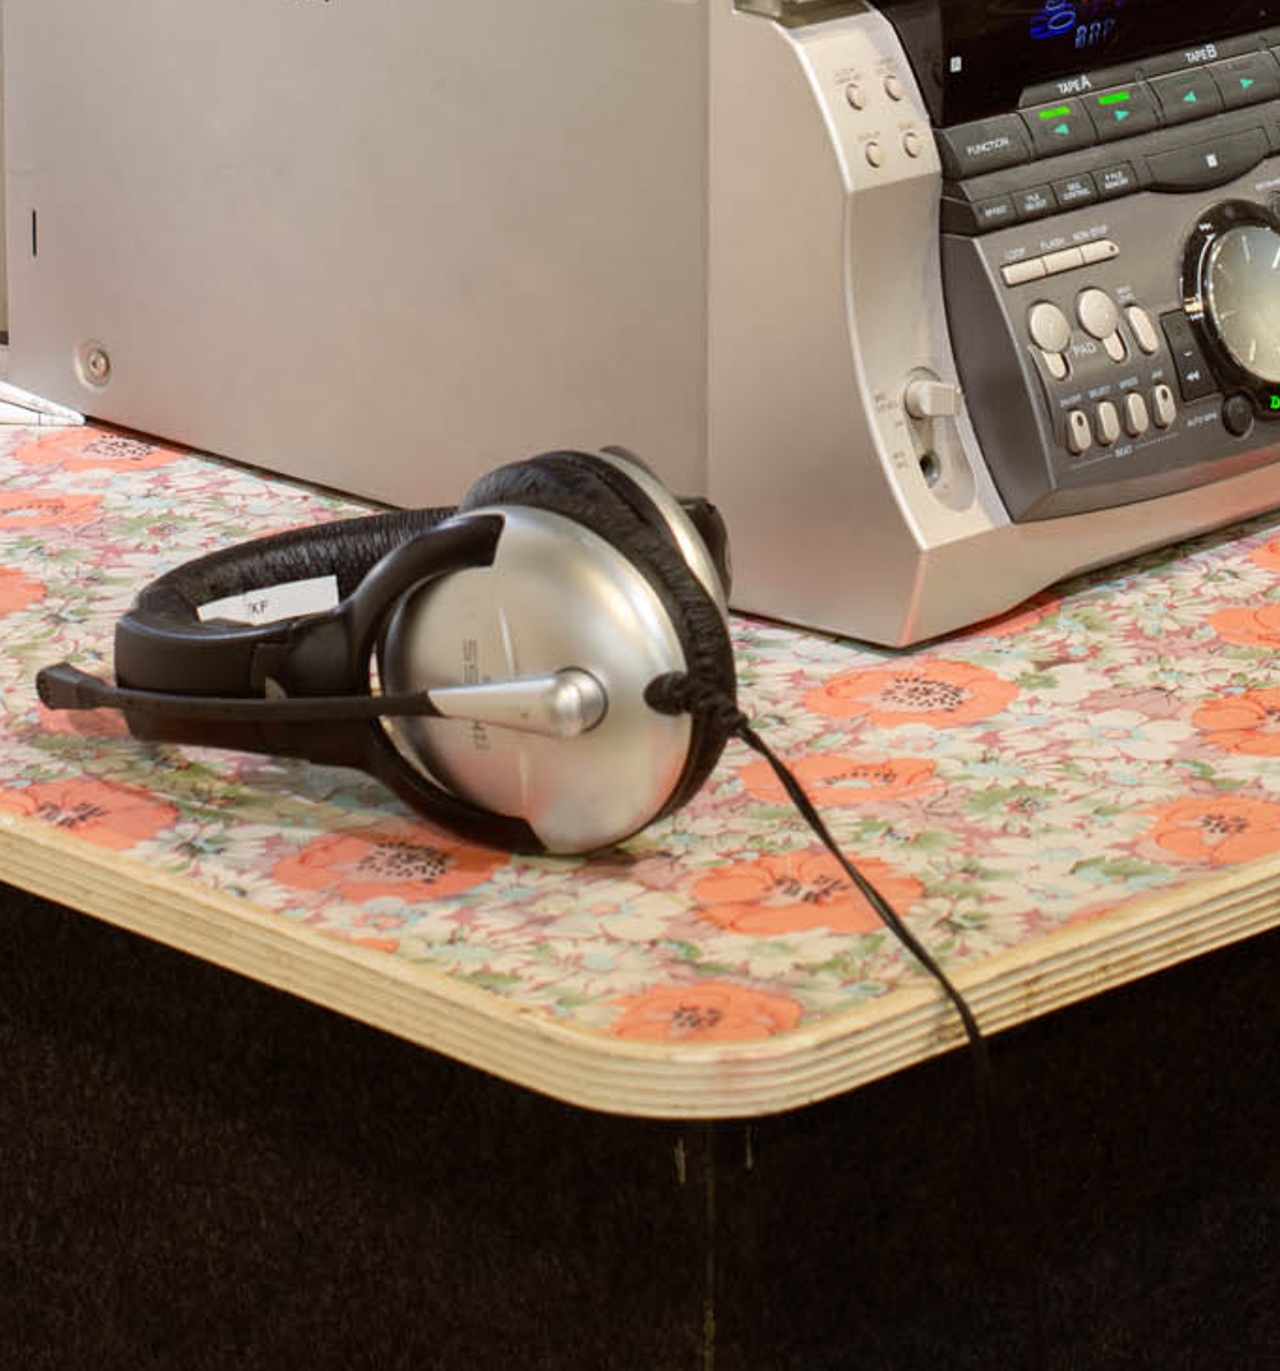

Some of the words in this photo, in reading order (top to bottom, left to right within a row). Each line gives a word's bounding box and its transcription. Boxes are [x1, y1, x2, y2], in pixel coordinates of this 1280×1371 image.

[1185, 49, 1207, 63] TAPE
[1056, 80, 1081, 94] TAPE
[966, 136, 1010, 157] FUNCTION
[1073, 342, 1098, 356] PAD
